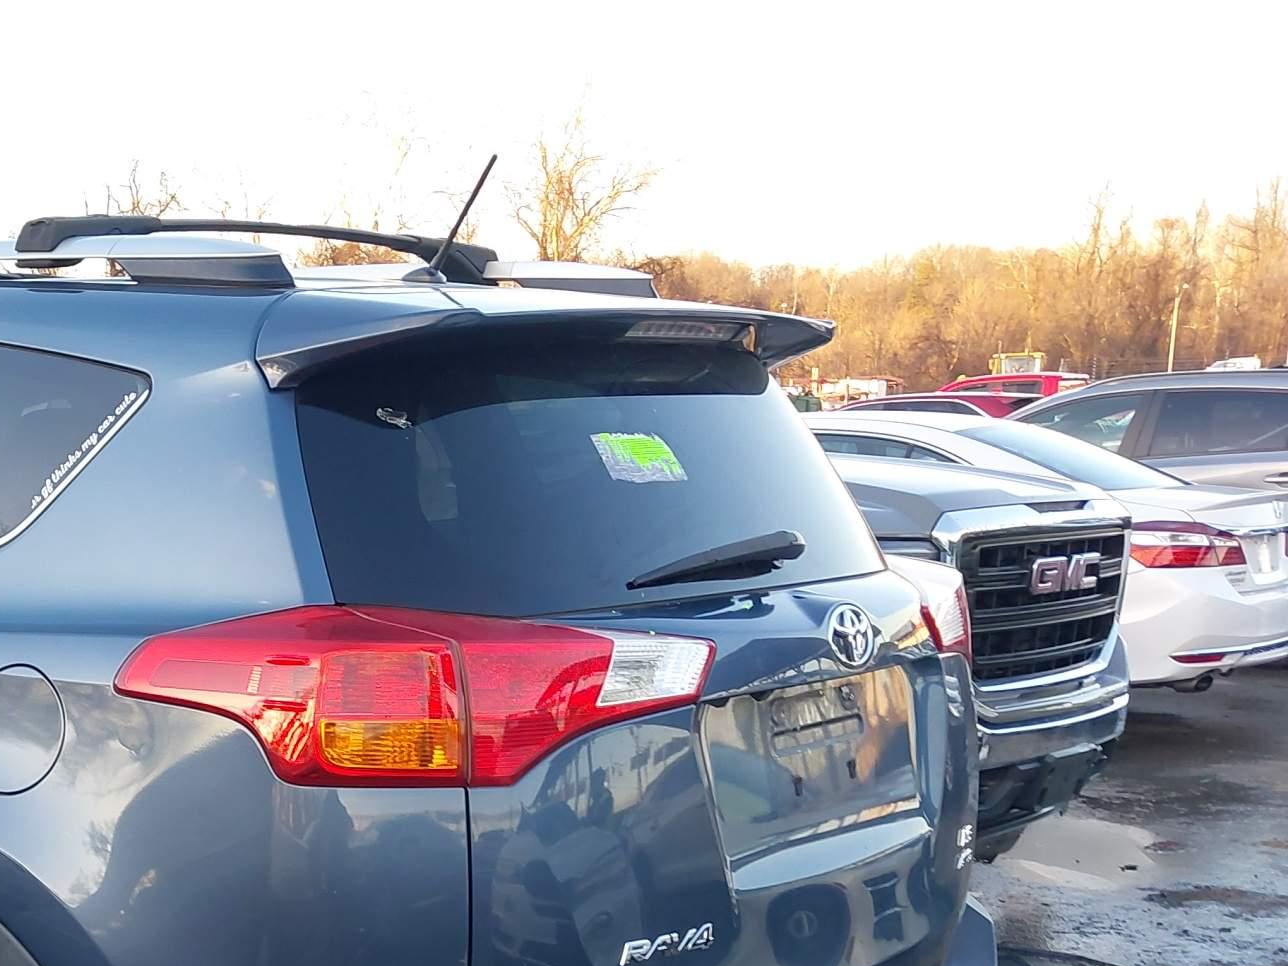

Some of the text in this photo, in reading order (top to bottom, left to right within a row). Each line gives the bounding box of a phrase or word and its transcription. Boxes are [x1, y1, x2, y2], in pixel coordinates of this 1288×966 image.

[41, 478, 53, 499] gf
[51, 449, 82, 483] thinks
[81, 432, 98, 452] my
[97, 415, 115, 434] car
[114, 391, 137, 416] cute
[1031, 551, 1101, 596] GMC
[619, 922, 715, 966] RAV4
